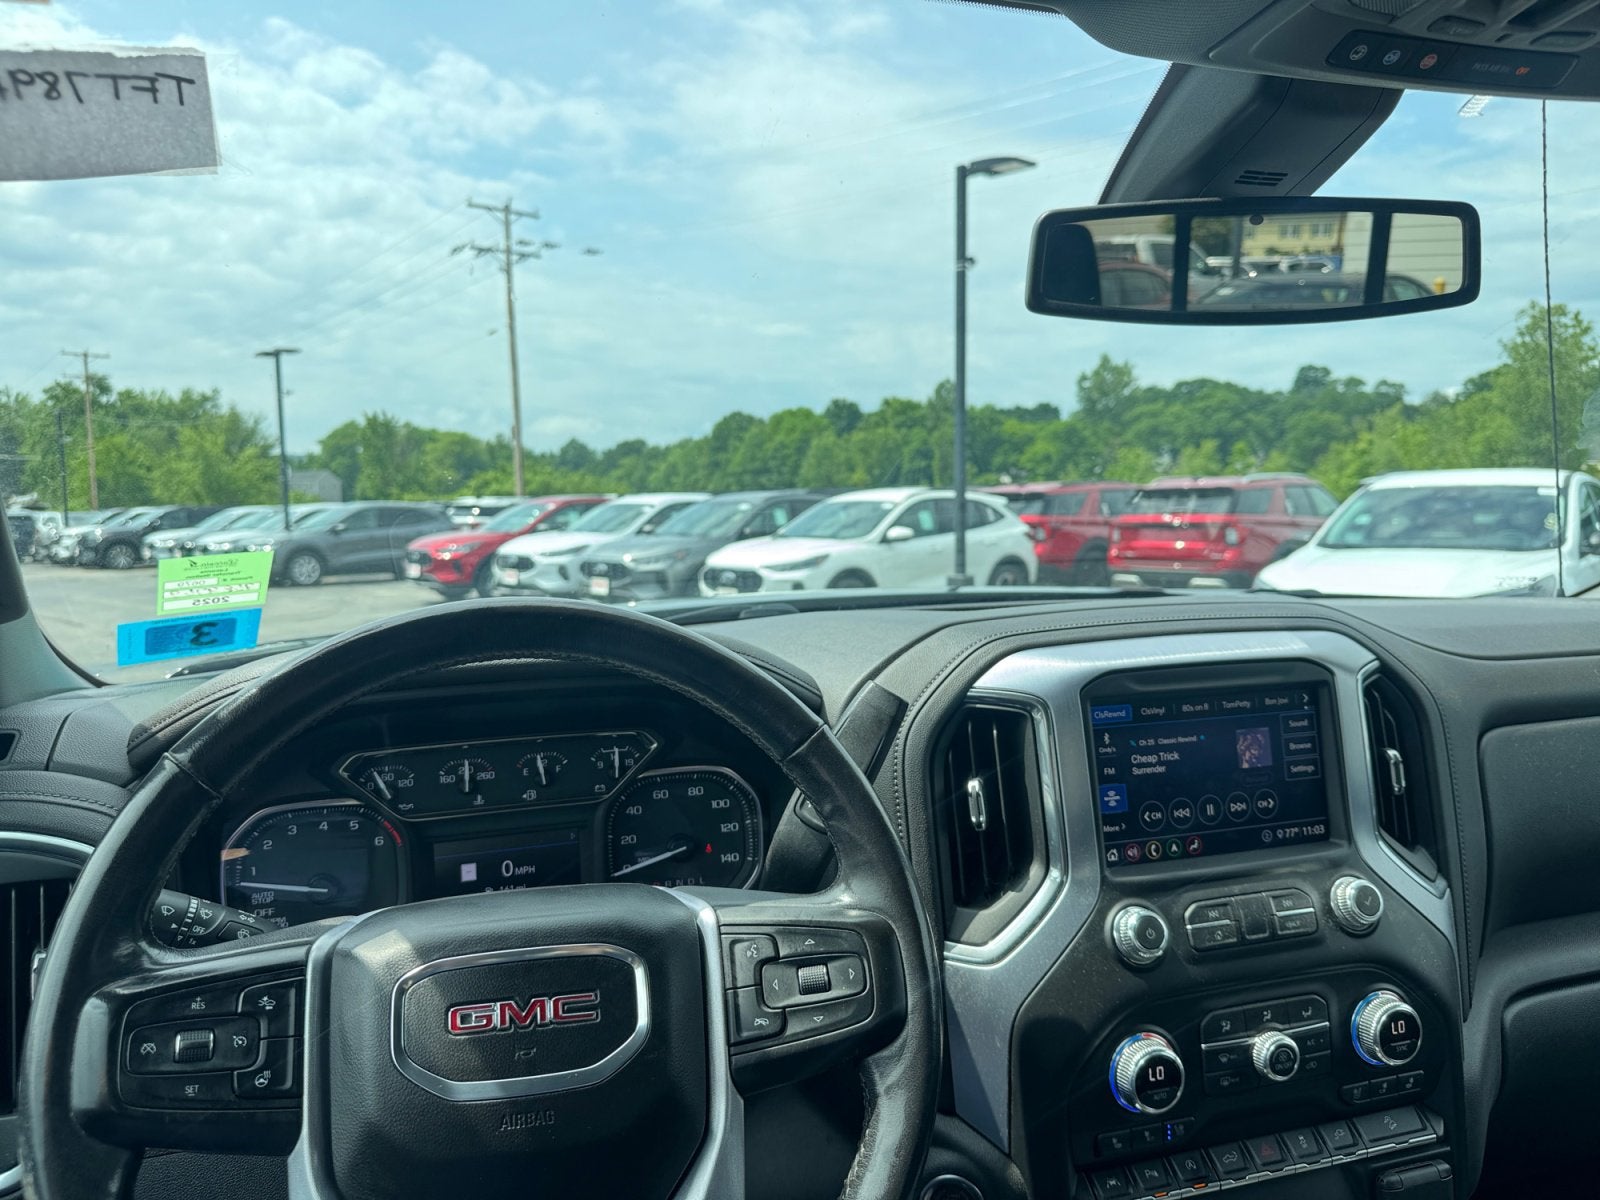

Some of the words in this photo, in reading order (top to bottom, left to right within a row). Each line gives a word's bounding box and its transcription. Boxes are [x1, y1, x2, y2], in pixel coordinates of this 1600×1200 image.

[1288, 719, 1309, 727] Sound
[1288, 742, 1312, 750] Browse
[625, 757, 634, 767] 19
[1131, 754, 1158, 764] Cheap
[1159, 751, 1180, 761] Trick
[555, 764, 563, 774] F
[596, 760, 604, 769] 9
[1289, 765, 1315, 774] Settings
[458, 765, 474, 775] 20
[476, 770, 496, 780] 260
[523, 767, 529, 776] E
[1132, 765, 1166, 775] Surrender
[397, 778, 414, 788] 120
[439, 774, 456, 784] 160
[653, 789, 669, 799] 60
[687, 786, 704, 796] 80
[711, 799, 730, 809] 100
[625, 805, 642, 816] 40
[318, 821, 329, 831] 4
[350, 820, 359, 829] 5
[720, 822, 739, 833] 120
[1103, 824, 1120, 833] More
[287, 825, 297, 835] 3
[1303, 825, 1325, 835] 11:03
[374, 836, 384, 846] 6
[620, 834, 637, 845] 20
[263, 840, 273, 850] 2
[720, 852, 740, 863] 140
[250, 866, 256, 876] 1
[502, 860, 513, 877] 0
[515, 865, 536, 875] MPH
[250, 890, 274, 898] AUTO
[254, 907, 276, 917] OFF
[192, 925, 206, 934] OFF
[191, 1002, 206, 1010] RES
[448, 989, 601, 1036] GMC
[185, 1085, 200, 1093] SET
[501, 1111, 556, 1131] AIRBAG
